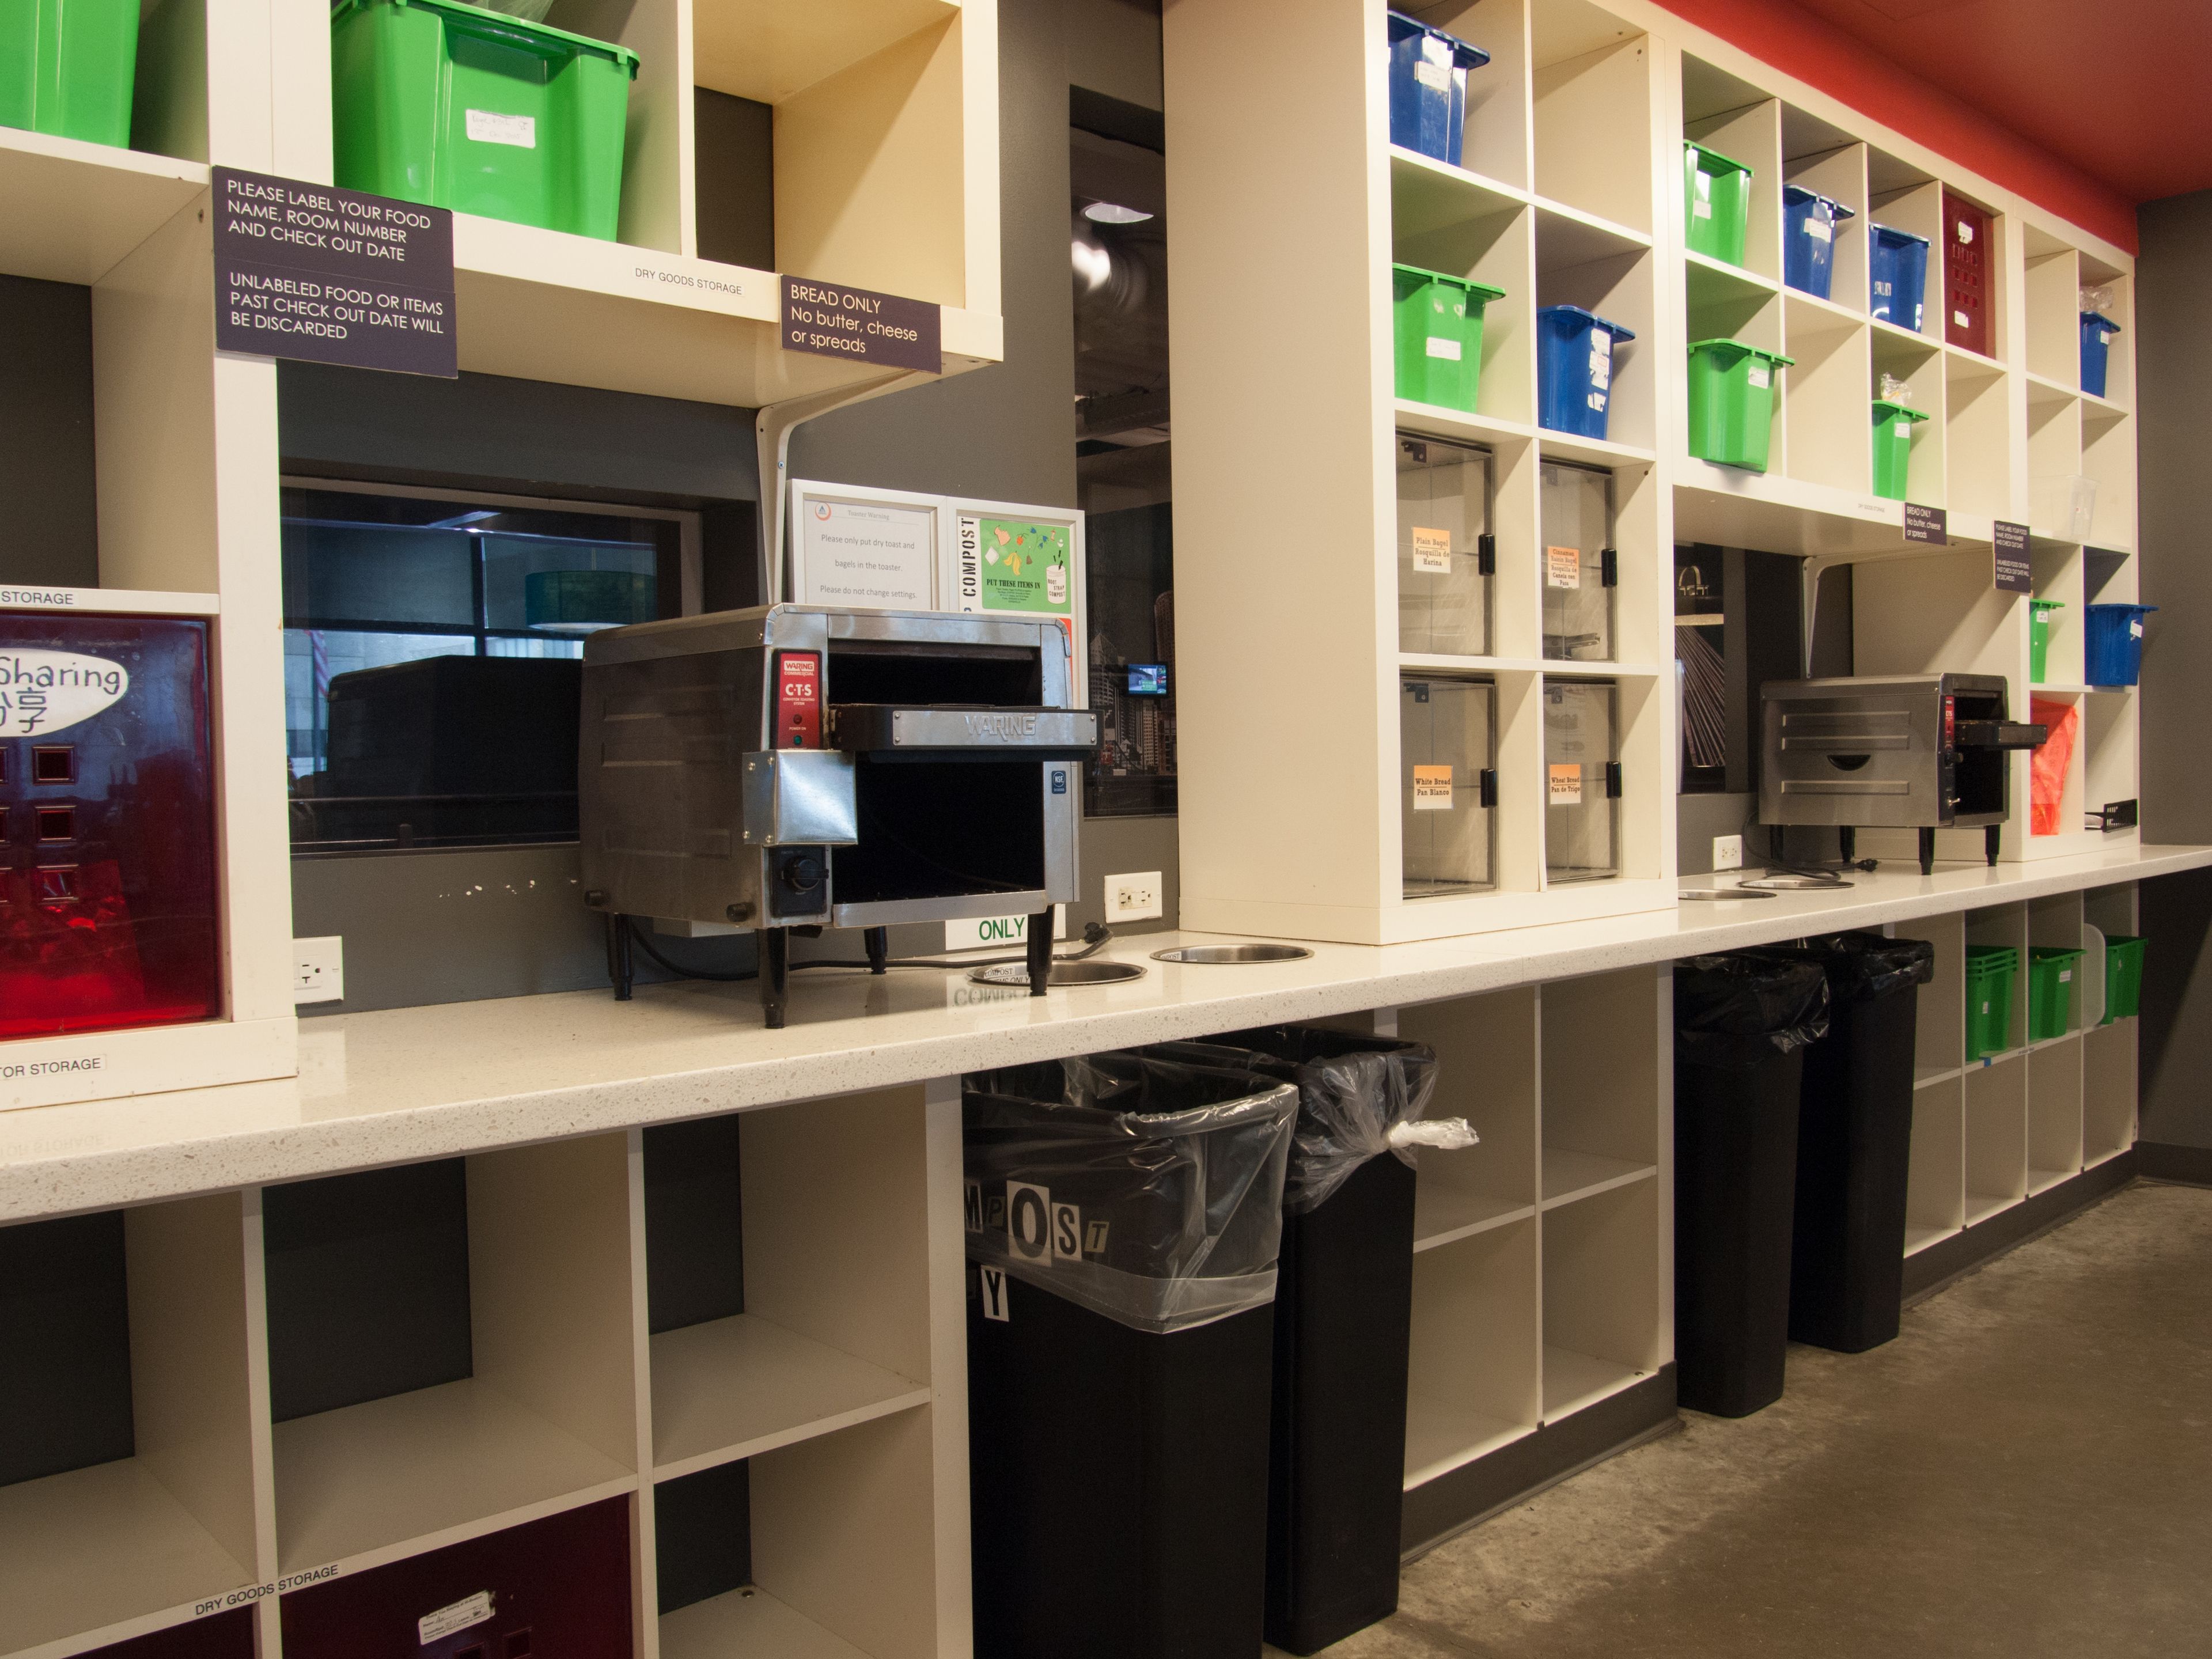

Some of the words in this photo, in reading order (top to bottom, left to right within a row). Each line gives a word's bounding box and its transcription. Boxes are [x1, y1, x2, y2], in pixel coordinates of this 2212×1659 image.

[228, 180, 285, 202] PLEASE
[289, 191, 334, 211] LABEL
[338, 200, 381, 220] YOUR
[386, 210, 430, 229] FOOD
[228, 200, 282, 222] NAME,
[287, 210, 339, 231] ROOM
[345, 221, 406, 243] NUMBER
[228, 220, 266, 237] AND
[271, 227, 327, 248] CHECK
[332, 237, 362, 253] OUT
[368, 243, 405, 261] DATE
[230, 272, 321, 297] UNLABELED
[326, 286, 372, 305] FOOD
[377, 294, 399, 309] OR
[404, 298, 443, 315] ITEMS
[635, 268, 656, 280] DRY
[659, 271, 694, 286] GOODS
[697, 279, 742, 295] STORAGE
[791, 285, 838, 306] BREAD
[843, 294, 881, 314] ONLY
[231, 292, 269, 308] PAST
[274, 298, 329, 318] CHECK
[334, 306, 365, 323] OUT
[370, 312, 407, 329] DATE
[411, 318, 444, 334] WILL
[791, 306, 812, 323] No
[817, 310, 863, 333] butter,
[868, 321, 918, 341] cheese
[231, 312, 250, 327] BE
[255, 315, 347, 339] DISCARDED
[791, 330, 806, 343] or
[810, 333, 866, 353] spreads
[848, 510, 866, 518] Toaster
[868, 512, 889, 521] Warning
[1907, 506, 1919, 516] BREAD
[1921, 509, 1931, 518] ONLY
[821, 534, 843, 543] Please
[844, 537, 858, 546] only
[873, 539, 884, 547] dry
[1416, 537, 1431, 545] Plain
[1433, 539, 1448, 548] Bagel
[835, 559, 855, 569] bagels
[878, 563, 903, 571] toaster.
[961, 518, 976, 597] COMPOST
[1415, 548, 1441, 558] Rosquilla
[1423, 558, 1442, 566] Harina
[1, 591, 74, 605] STORAGE
[820, 585, 841, 593] Please
[866, 589, 889, 597] change
[891, 590, 917, 600] settings.
[0, 657, 120, 695] Sharing
[786, 662, 813, 671] WARING
[964, 715, 1036, 741] WARING
[979, 917, 1025, 940] ONLY
[0, 1065, 25, 1078] OR
[31, 1058, 101, 1075] STORAGE
[195, 1598, 222, 1615] DRY
[227, 1584, 274, 1605] GOODS
[278, 1565, 338, 1590] STORAGE
